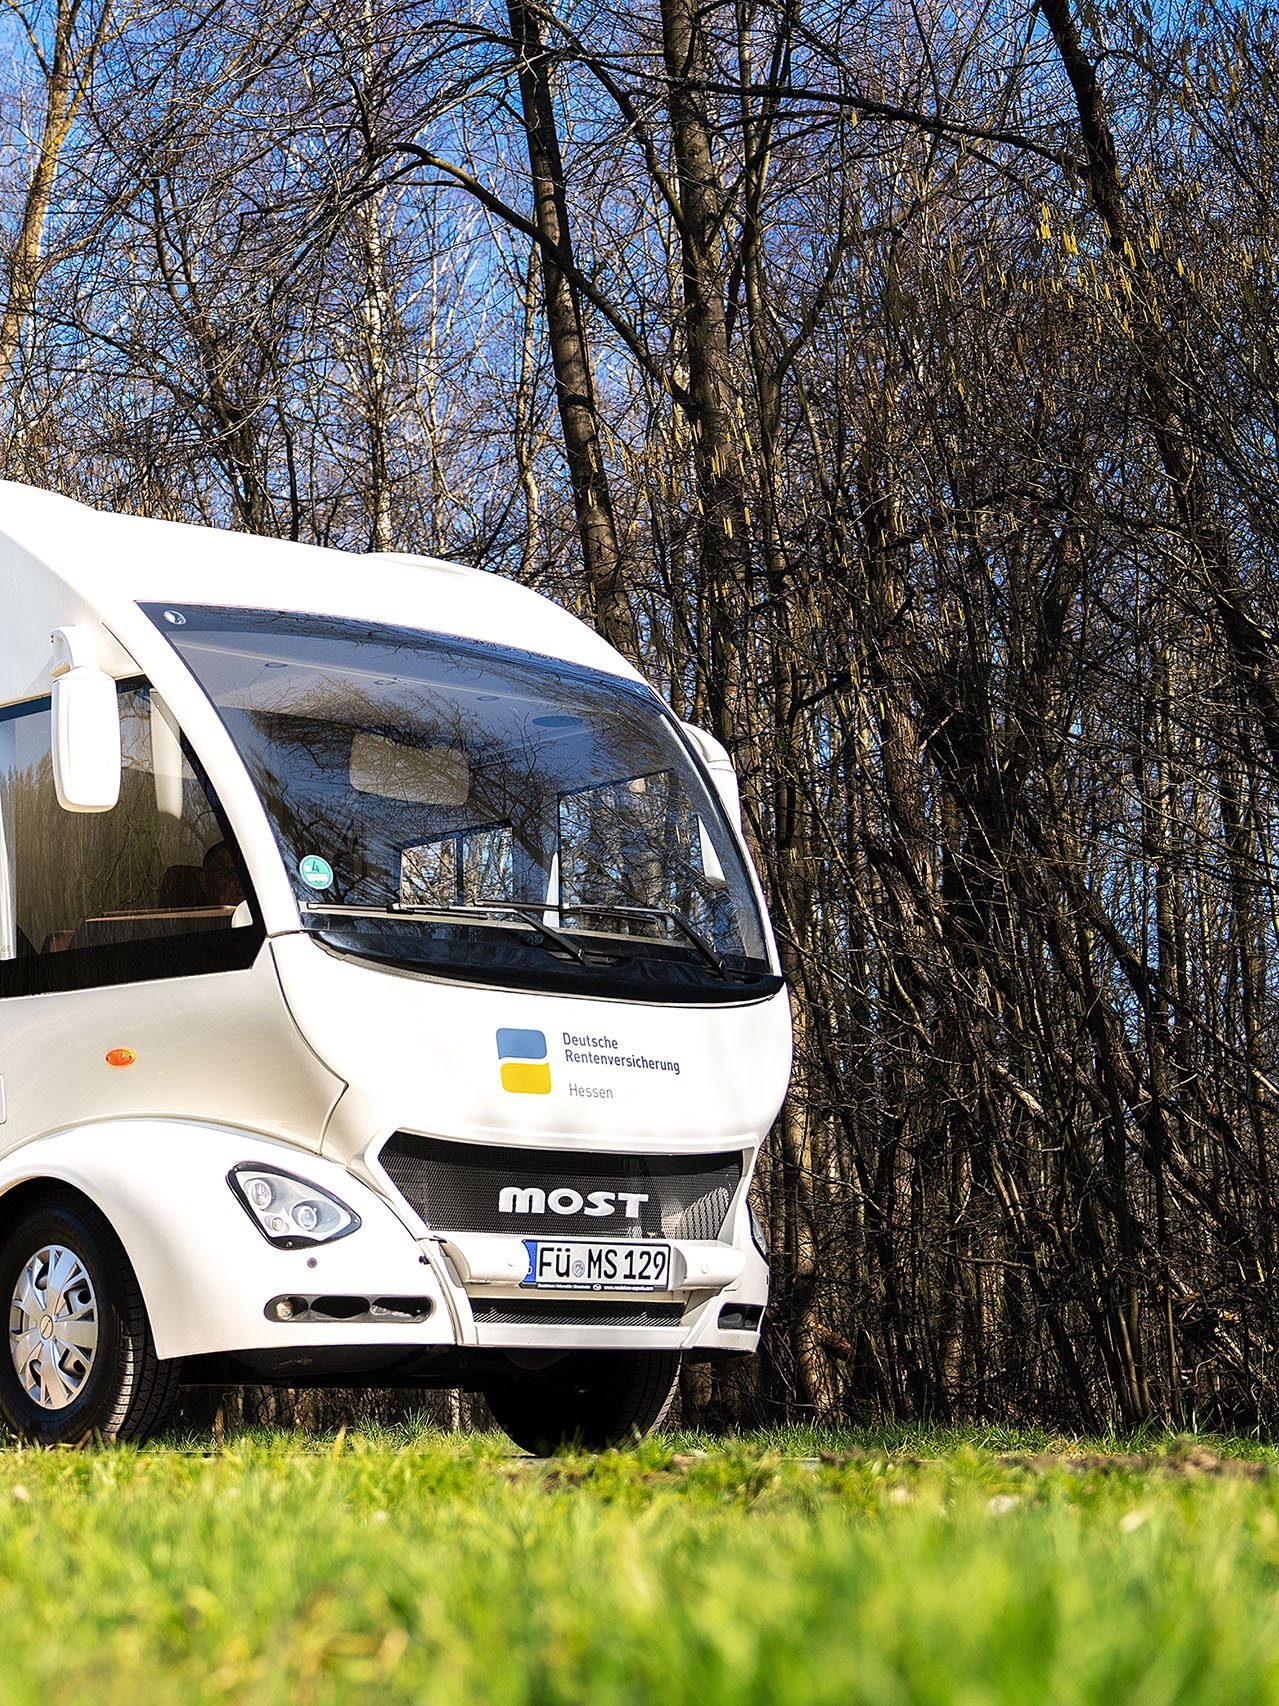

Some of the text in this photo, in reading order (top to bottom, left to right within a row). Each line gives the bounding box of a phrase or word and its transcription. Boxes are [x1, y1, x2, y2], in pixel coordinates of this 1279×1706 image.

[311, 860, 320, 872] 4
[562, 1032, 618, 1049] Deutsche
[565, 1049, 680, 1075] Rentenversicherung
[569, 1083, 613, 1099] Hessen
[539, 1246, 666, 1280] FÜ MS 129
